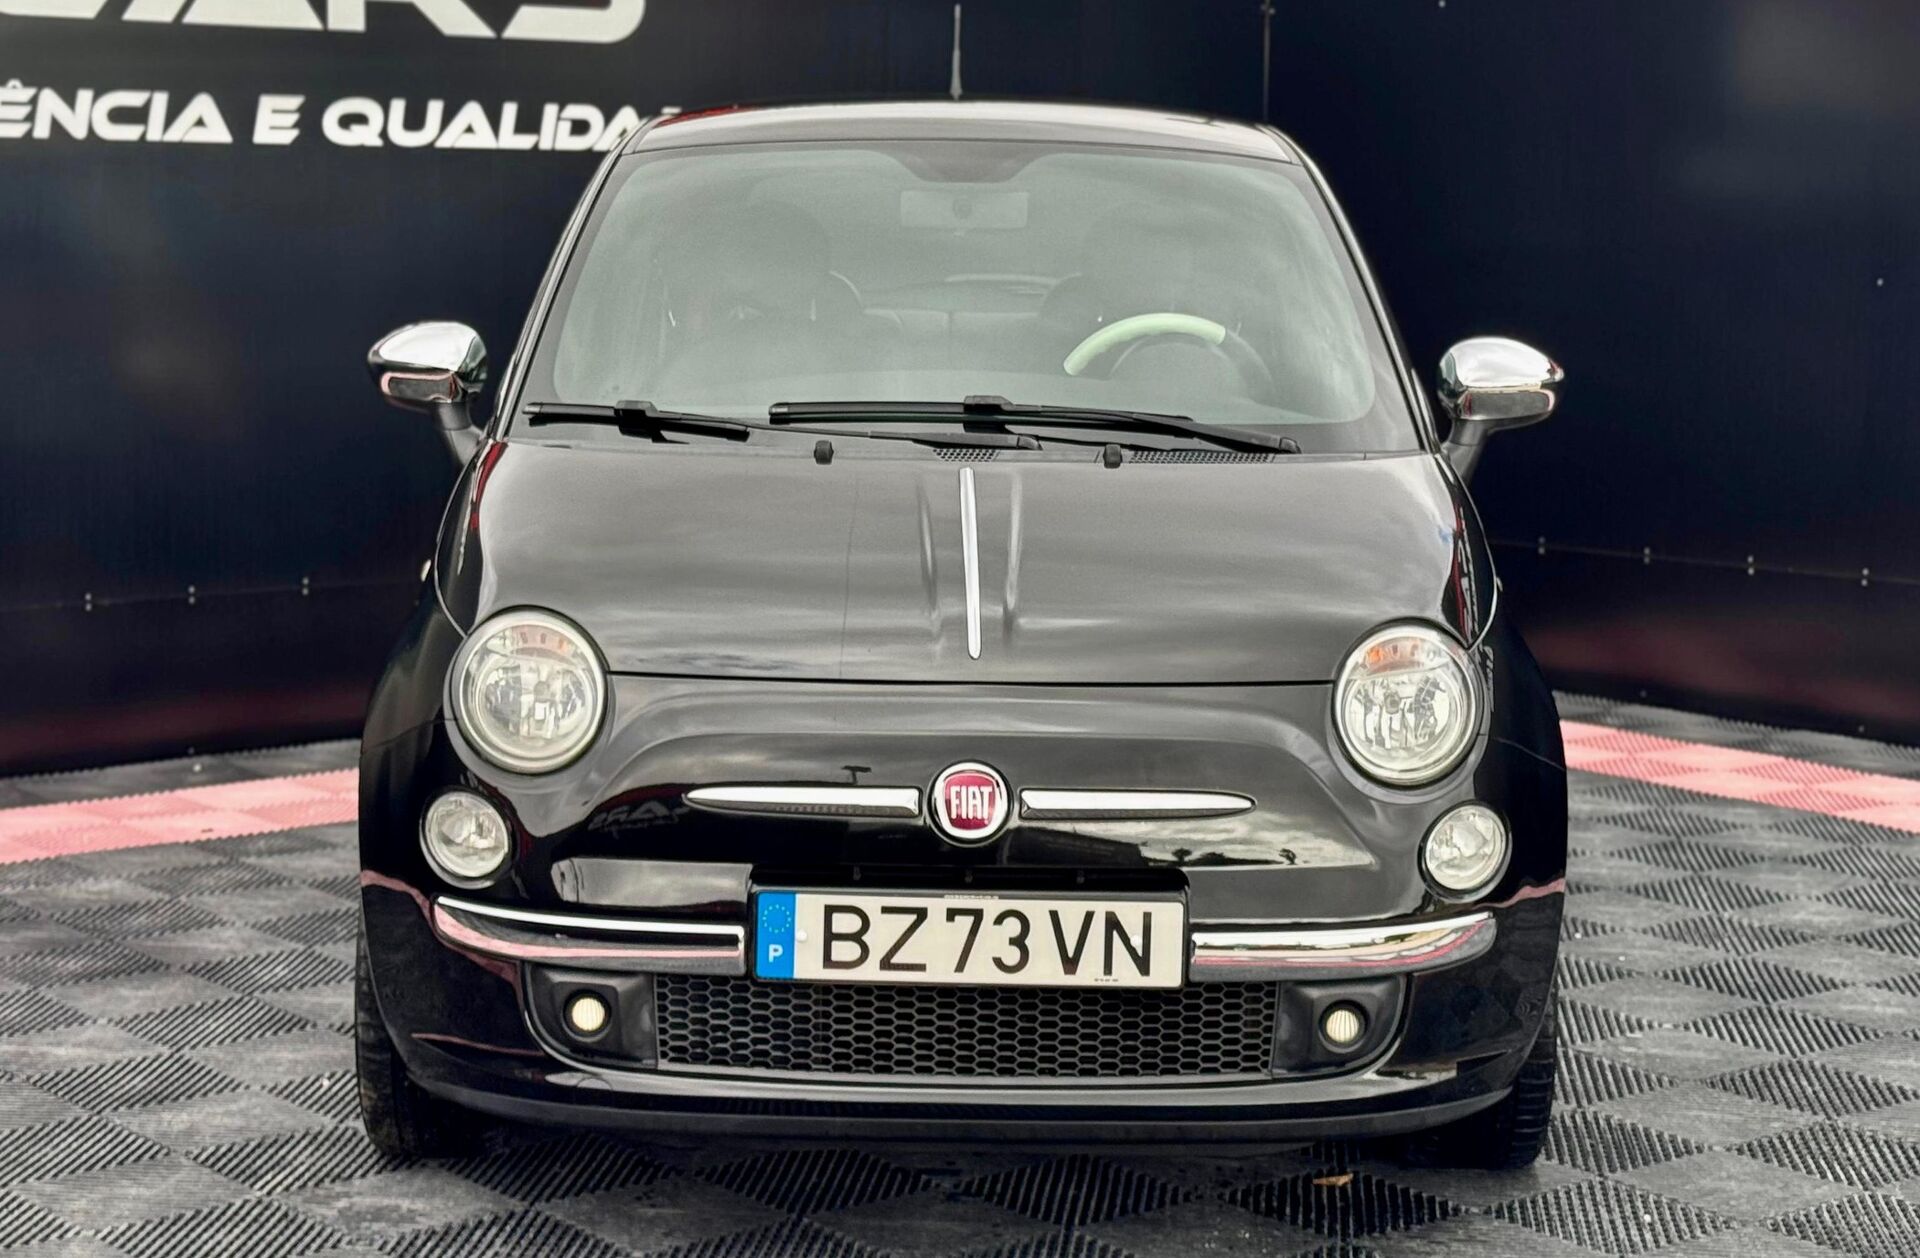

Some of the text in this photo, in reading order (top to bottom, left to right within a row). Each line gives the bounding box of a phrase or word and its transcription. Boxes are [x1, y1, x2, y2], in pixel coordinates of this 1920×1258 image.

[252, 95, 304, 145] E
[322, 97, 680, 152] QUALIDA
[950, 785, 993, 821] FIAT
[768, 945, 784, 963] P
[822, 904, 1152, 977] BZ 73 VN
